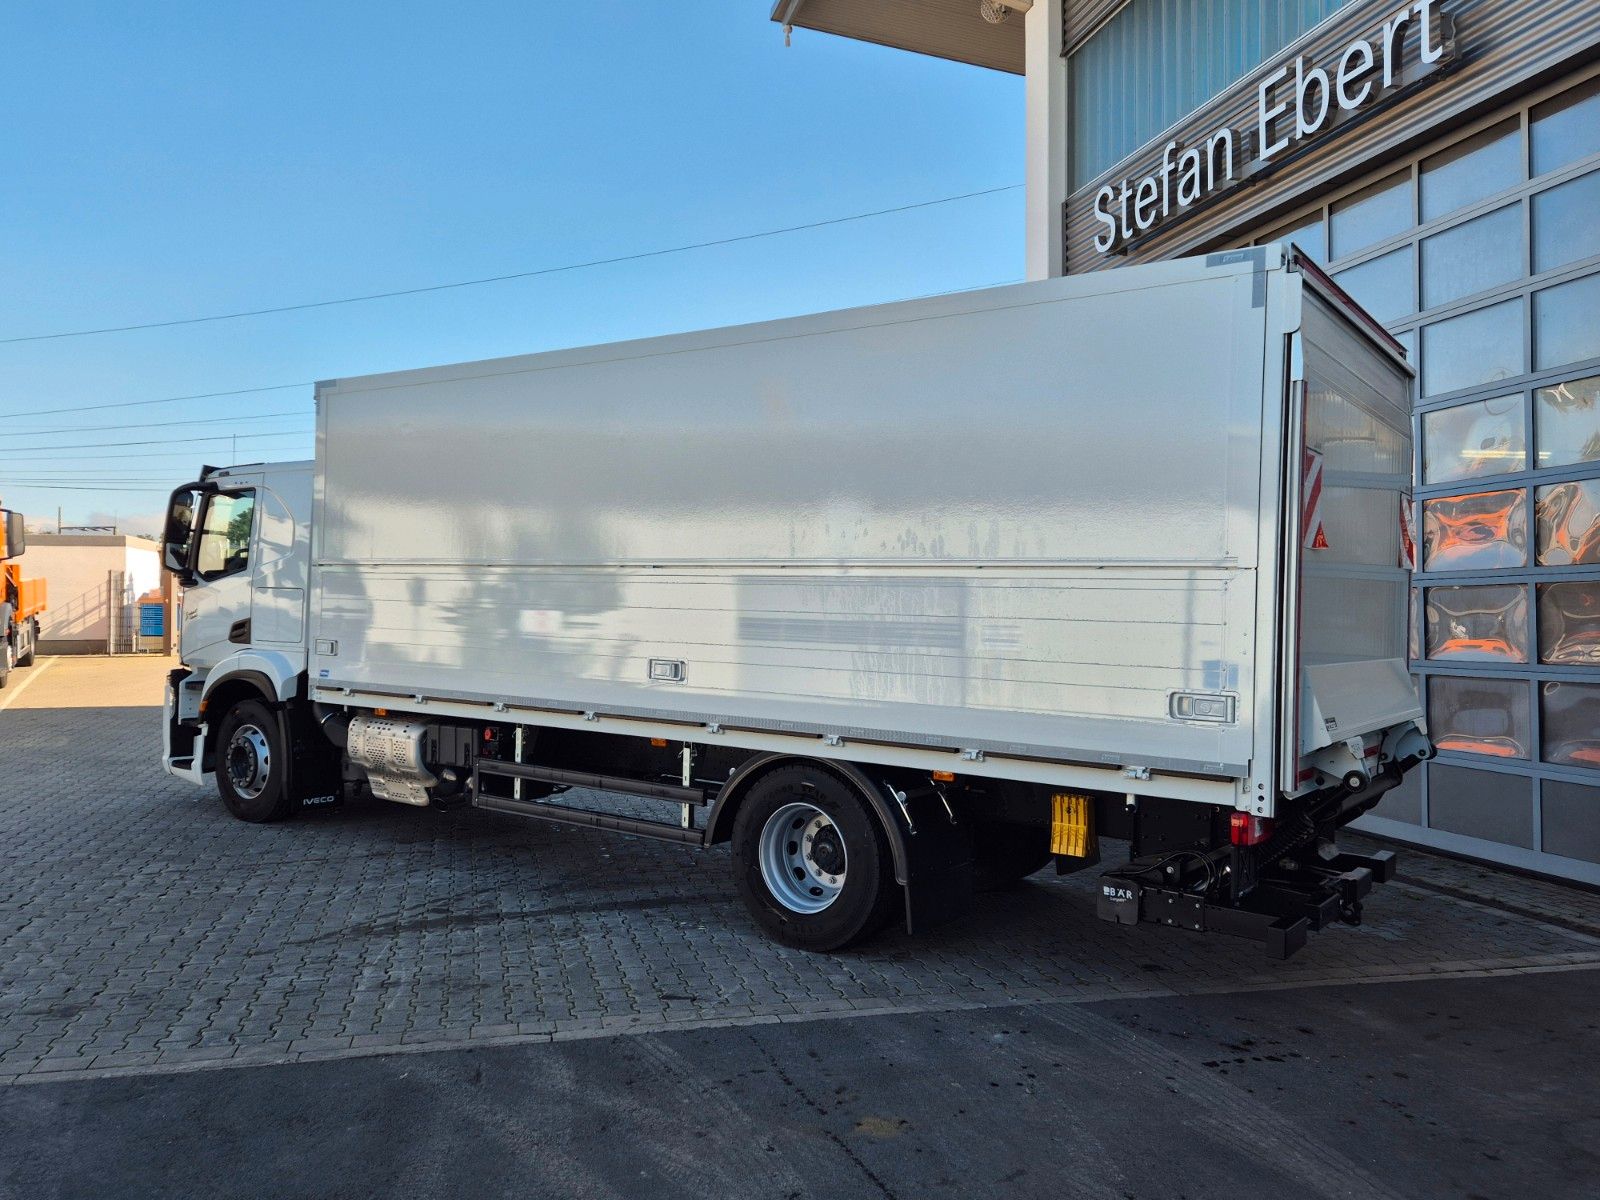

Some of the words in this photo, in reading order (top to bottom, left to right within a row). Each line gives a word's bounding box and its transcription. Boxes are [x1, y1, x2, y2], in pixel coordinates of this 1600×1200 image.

[1094, 128, 1233, 253] Stefan
[1259, 0, 1443, 161] Ebert
[303, 795, 335, 805] IVECO
